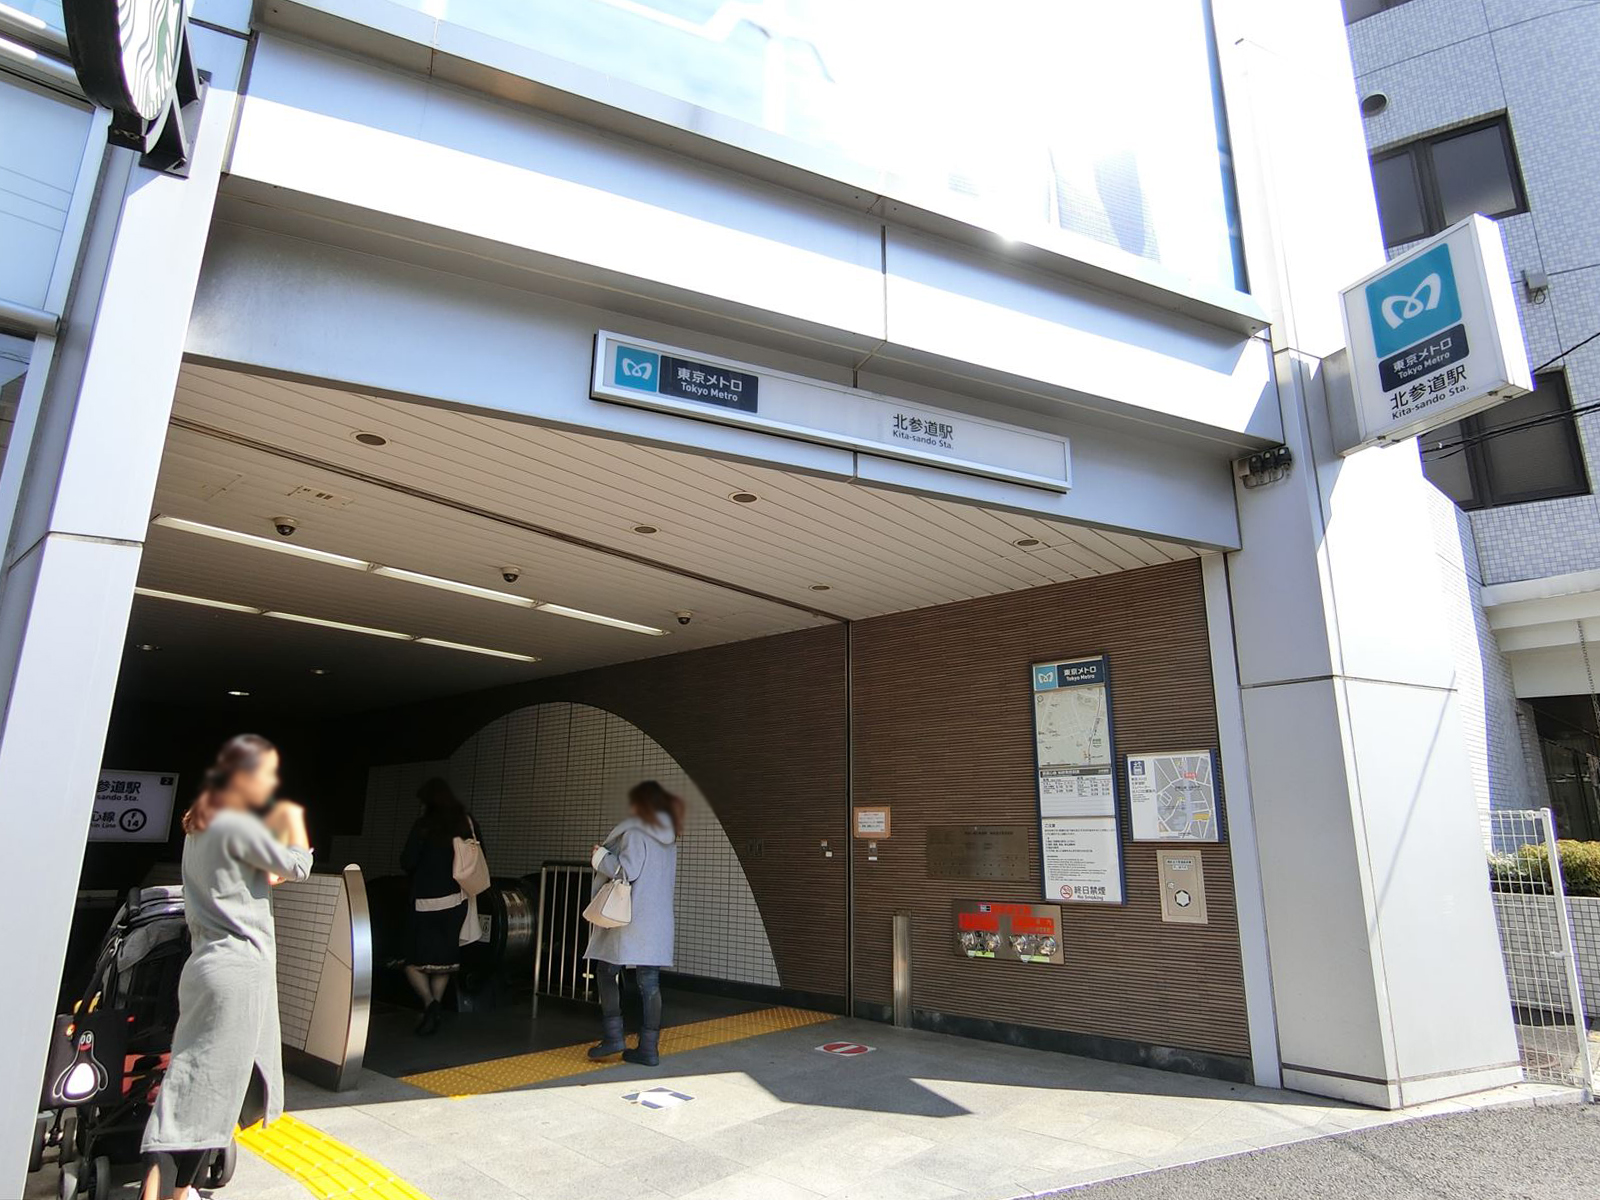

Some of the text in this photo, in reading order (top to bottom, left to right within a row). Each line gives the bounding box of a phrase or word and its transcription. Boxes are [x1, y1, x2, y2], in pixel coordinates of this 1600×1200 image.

[1392, 337, 1453, 372] 東京メトロ
[1398, 351, 1451, 379] Tokyo Metro
[676, 365, 744, 393] 東京メトロ
[1389, 364, 1467, 411] 北参道駅
[681, 381, 739, 403] Tokyo Metro
[1392, 384, 1470, 420] Kita-sando Sta.
[892, 412, 954, 441] 北参道駅
[892, 429, 954, 450] Kita-sando Sta.
[1063, 665, 1097, 676] 東京メトロ
[123, 795, 139, 803] Sta.
[127, 819, 139, 827] 14
[1074, 885, 1106, 895] 終日禁煙
